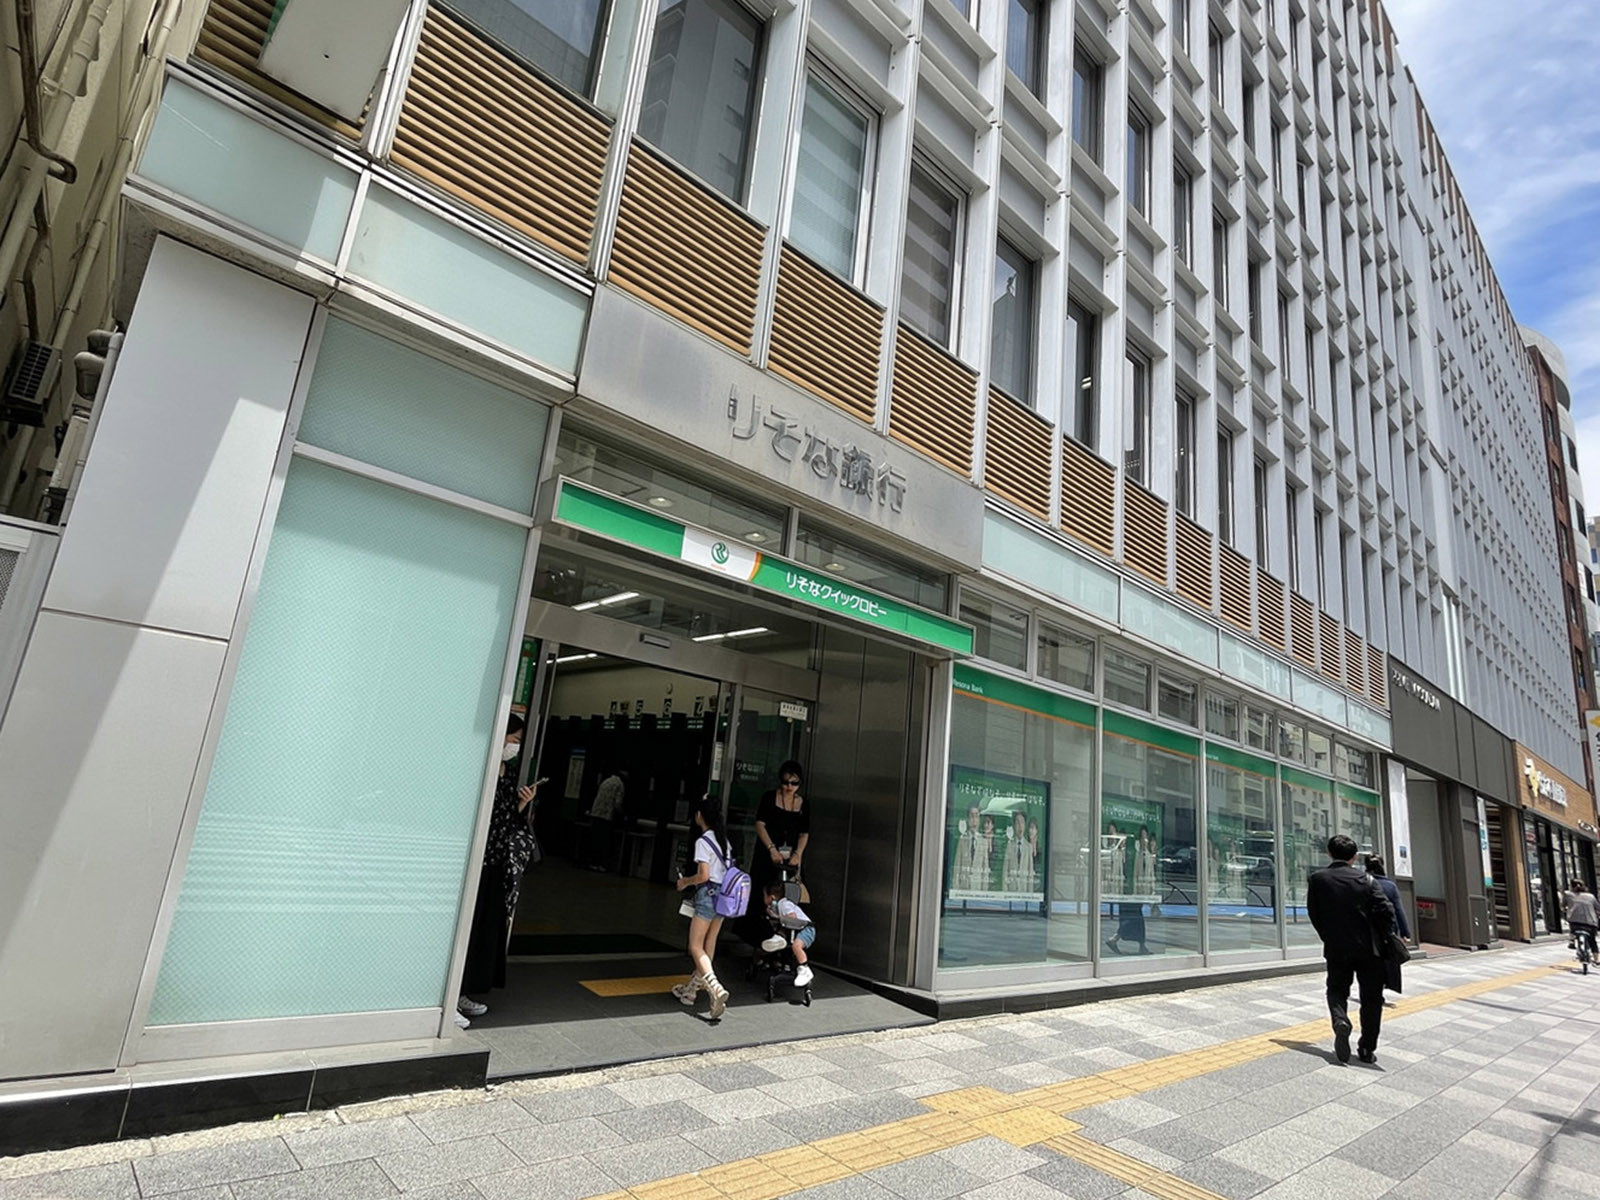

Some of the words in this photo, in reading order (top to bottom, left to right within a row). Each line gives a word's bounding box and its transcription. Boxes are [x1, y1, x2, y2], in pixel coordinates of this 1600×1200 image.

[728, 383, 906, 513] りそな銀行
[785, 572, 887, 616] りそなクイックロビー
